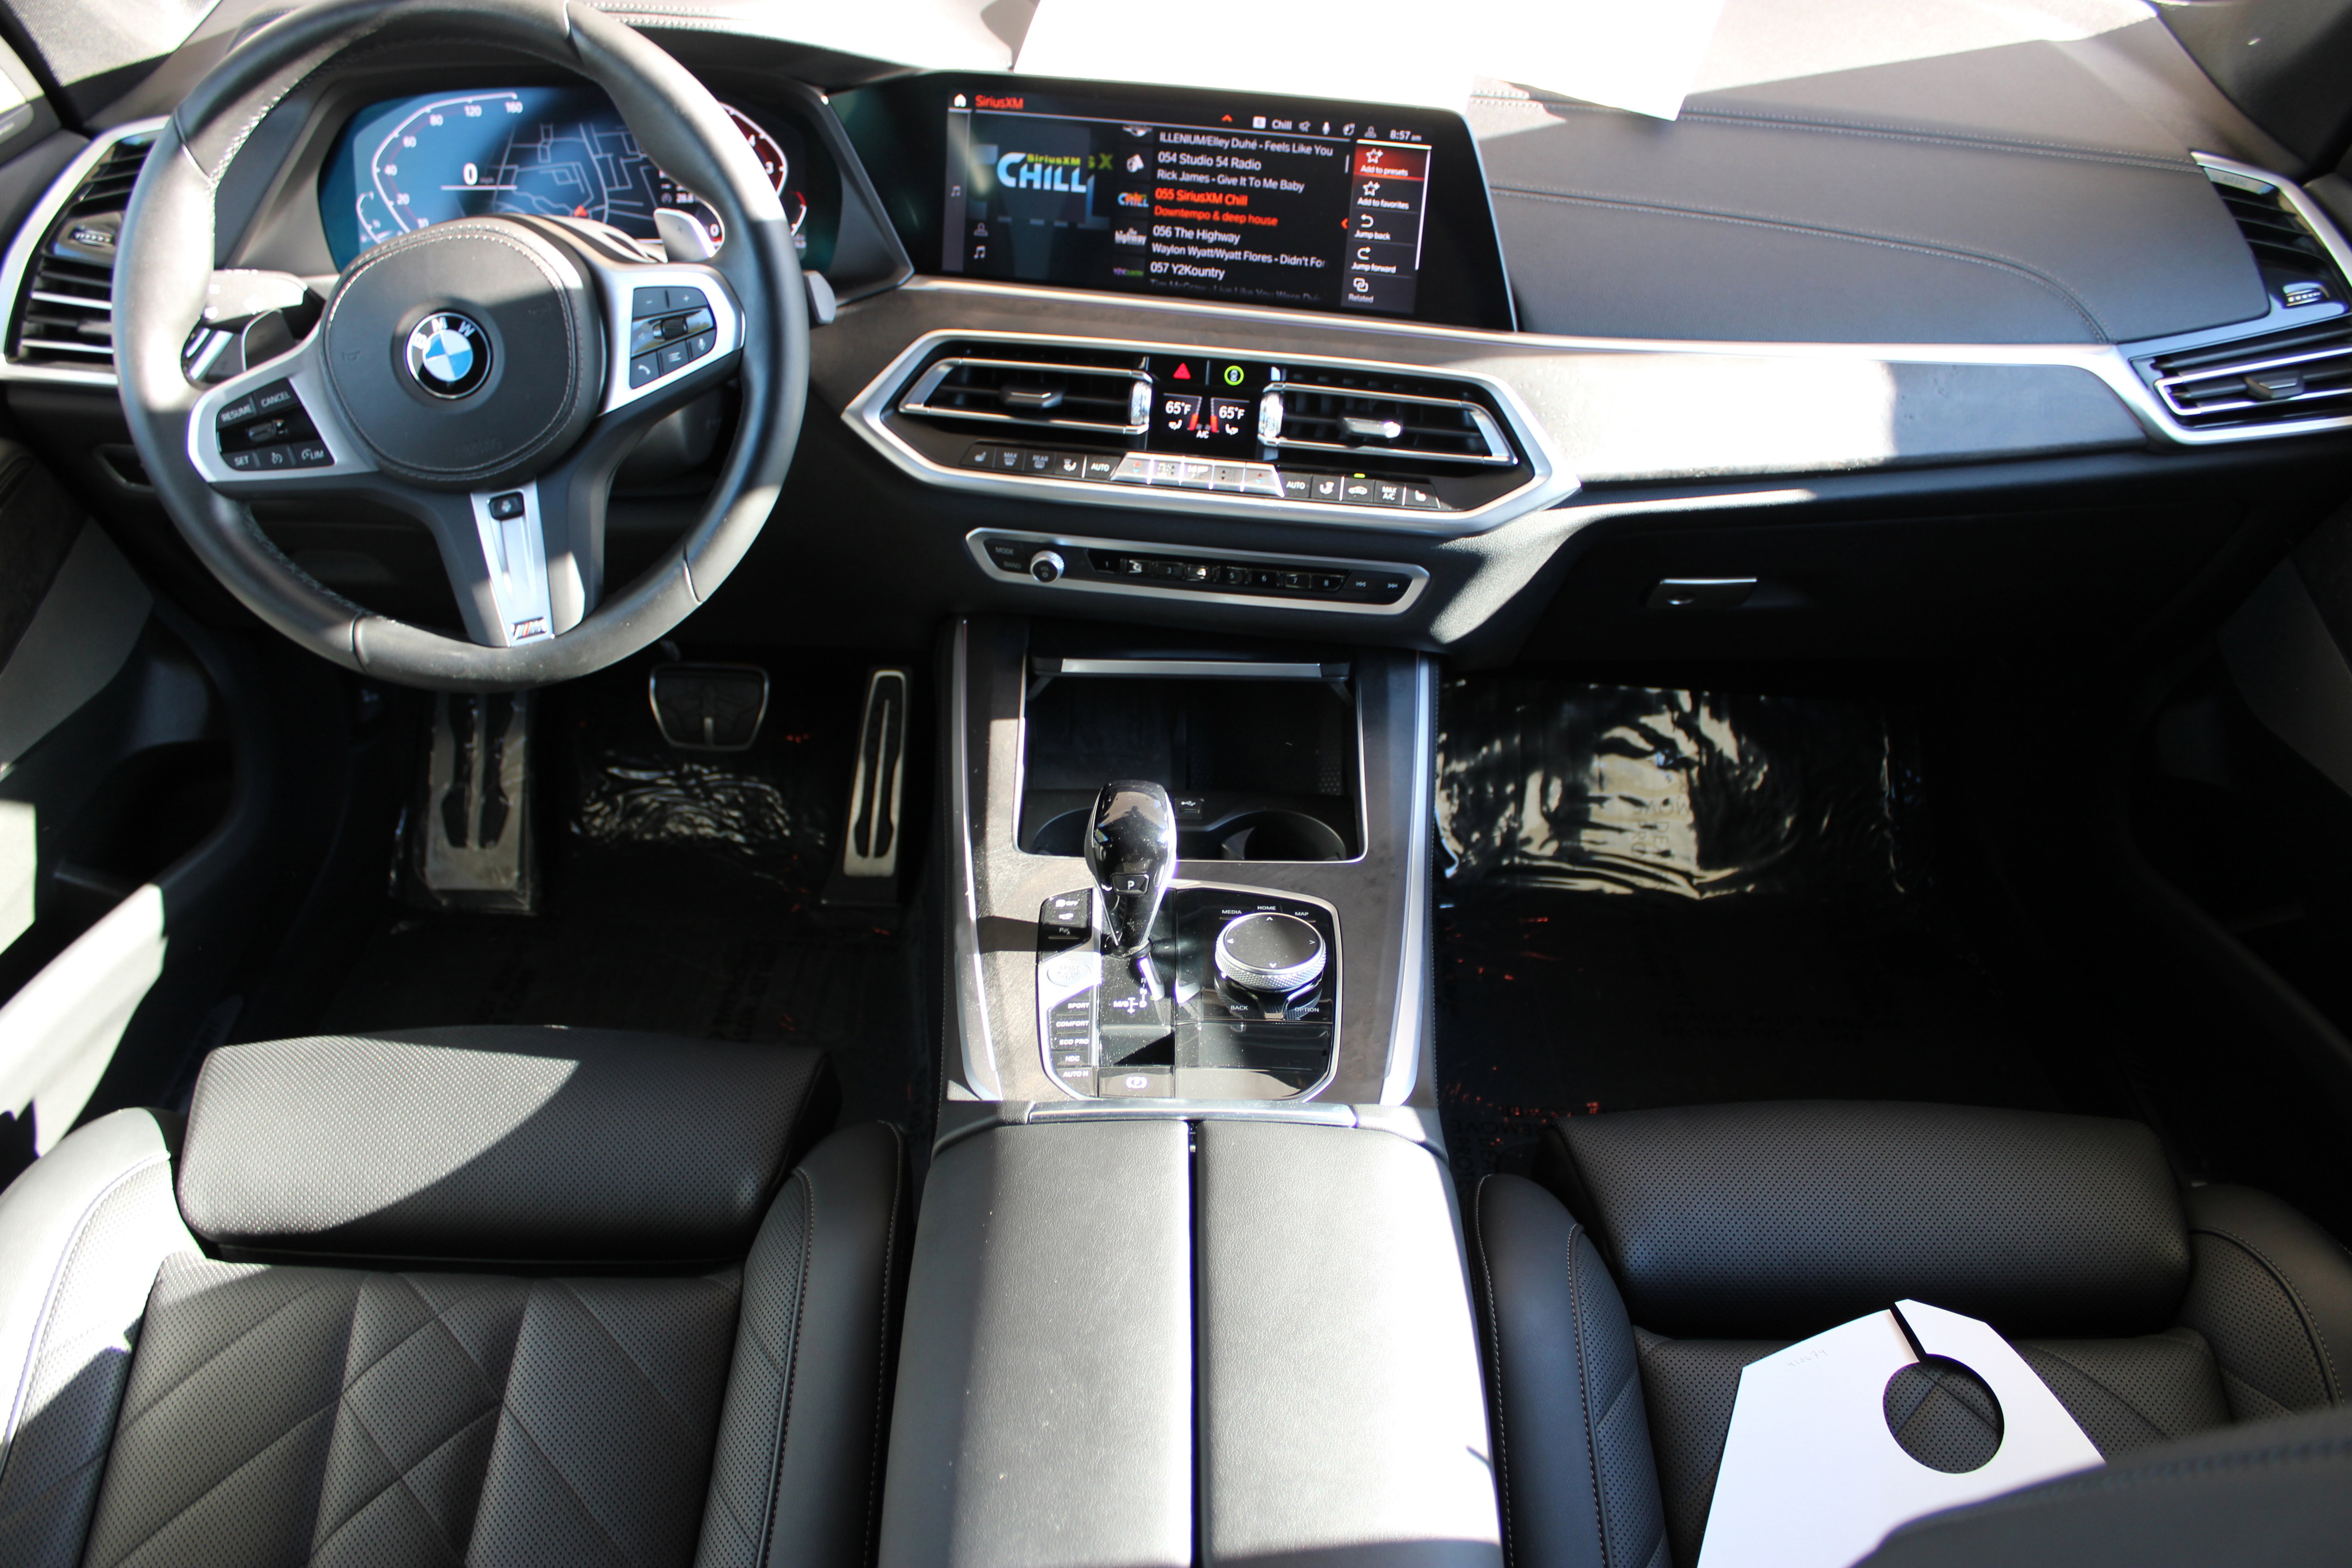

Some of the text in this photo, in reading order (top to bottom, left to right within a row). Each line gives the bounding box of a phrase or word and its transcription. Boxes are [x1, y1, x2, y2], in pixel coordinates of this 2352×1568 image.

[505, 102, 523, 114] 160
[975, 94, 1024, 109] SiriusXM
[464, 105, 482, 117] 120
[430, 114, 443, 127] 80
[1272, 119, 1292, 130] Chill
[1390, 129, 1411, 140] 8:57
[403, 136, 417, 148] 60
[1231, 137, 1258, 149] Duhé
[1264, 140, 1290, 153] Feels
[1292, 143, 1312, 154] Like
[1314, 145, 1333, 156] You
[1027, 153, 1081, 166] SiriusXM
[1158, 151, 1262, 171] 054 Studio 54 Radio
[384, 164, 398, 176] 40
[765, 160, 775, 174] 3
[997, 151, 1087, 194] CHILL
[1361, 165, 1409, 177] Add to presets
[463, 163, 478, 185] 0
[1157, 169, 1177, 180] Rick
[1179, 171, 1210, 183] James
[1217, 174, 1238, 186] Give
[1240, 176, 1246, 186] It
[1248, 176, 1261, 188] To
[1263, 178, 1278, 189] Me
[1280, 179, 1305, 194] Baby
[396, 193, 410, 205] 20
[1155, 187, 1248, 206] 055 SiriusXM Chill
[1357, 197, 1409, 210] Add to favorites
[1154, 205, 1278, 226] Downtempo & deep house
[710, 223, 719, 237] 0
[1153, 225, 1241, 245] 056 The Highway
[1354, 229, 1391, 241] Jump back
[1152, 243, 1186, 256] Waylon
[1187, 245, 1241, 261] Wyatt/Wyatt
[1243, 251, 1272, 263] Flores
[1280, 254, 1308, 267] Didn't
[1150, 261, 1169, 273] 057
[1171, 263, 1225, 281] Y2Kountry
[1351, 262, 1396, 274] Jump forward
[1348, 293, 1374, 303] Related
[413, 316, 477, 350] BMW
[261, 392, 290, 407] CANCEL
[221, 404, 254, 422] RESUME
[1165, 401, 1192, 415] 65°F
[1219, 405, 1245, 420] 65°F
[1196, 430, 1209, 439] A/C
[234, 455, 249, 467] SET
[1091, 463, 1110, 472] AUTO
[1286, 481, 1305, 490] AUTO
[1382, 486, 1397, 494] MAX
[1383, 492, 1396, 501] A/C
[995, 547, 1014, 555] MODE
[1003, 561, 1021, 569] BAND
[1127, 880, 1135, 890] P
[1786, 1348, 1829, 1368] 410674
